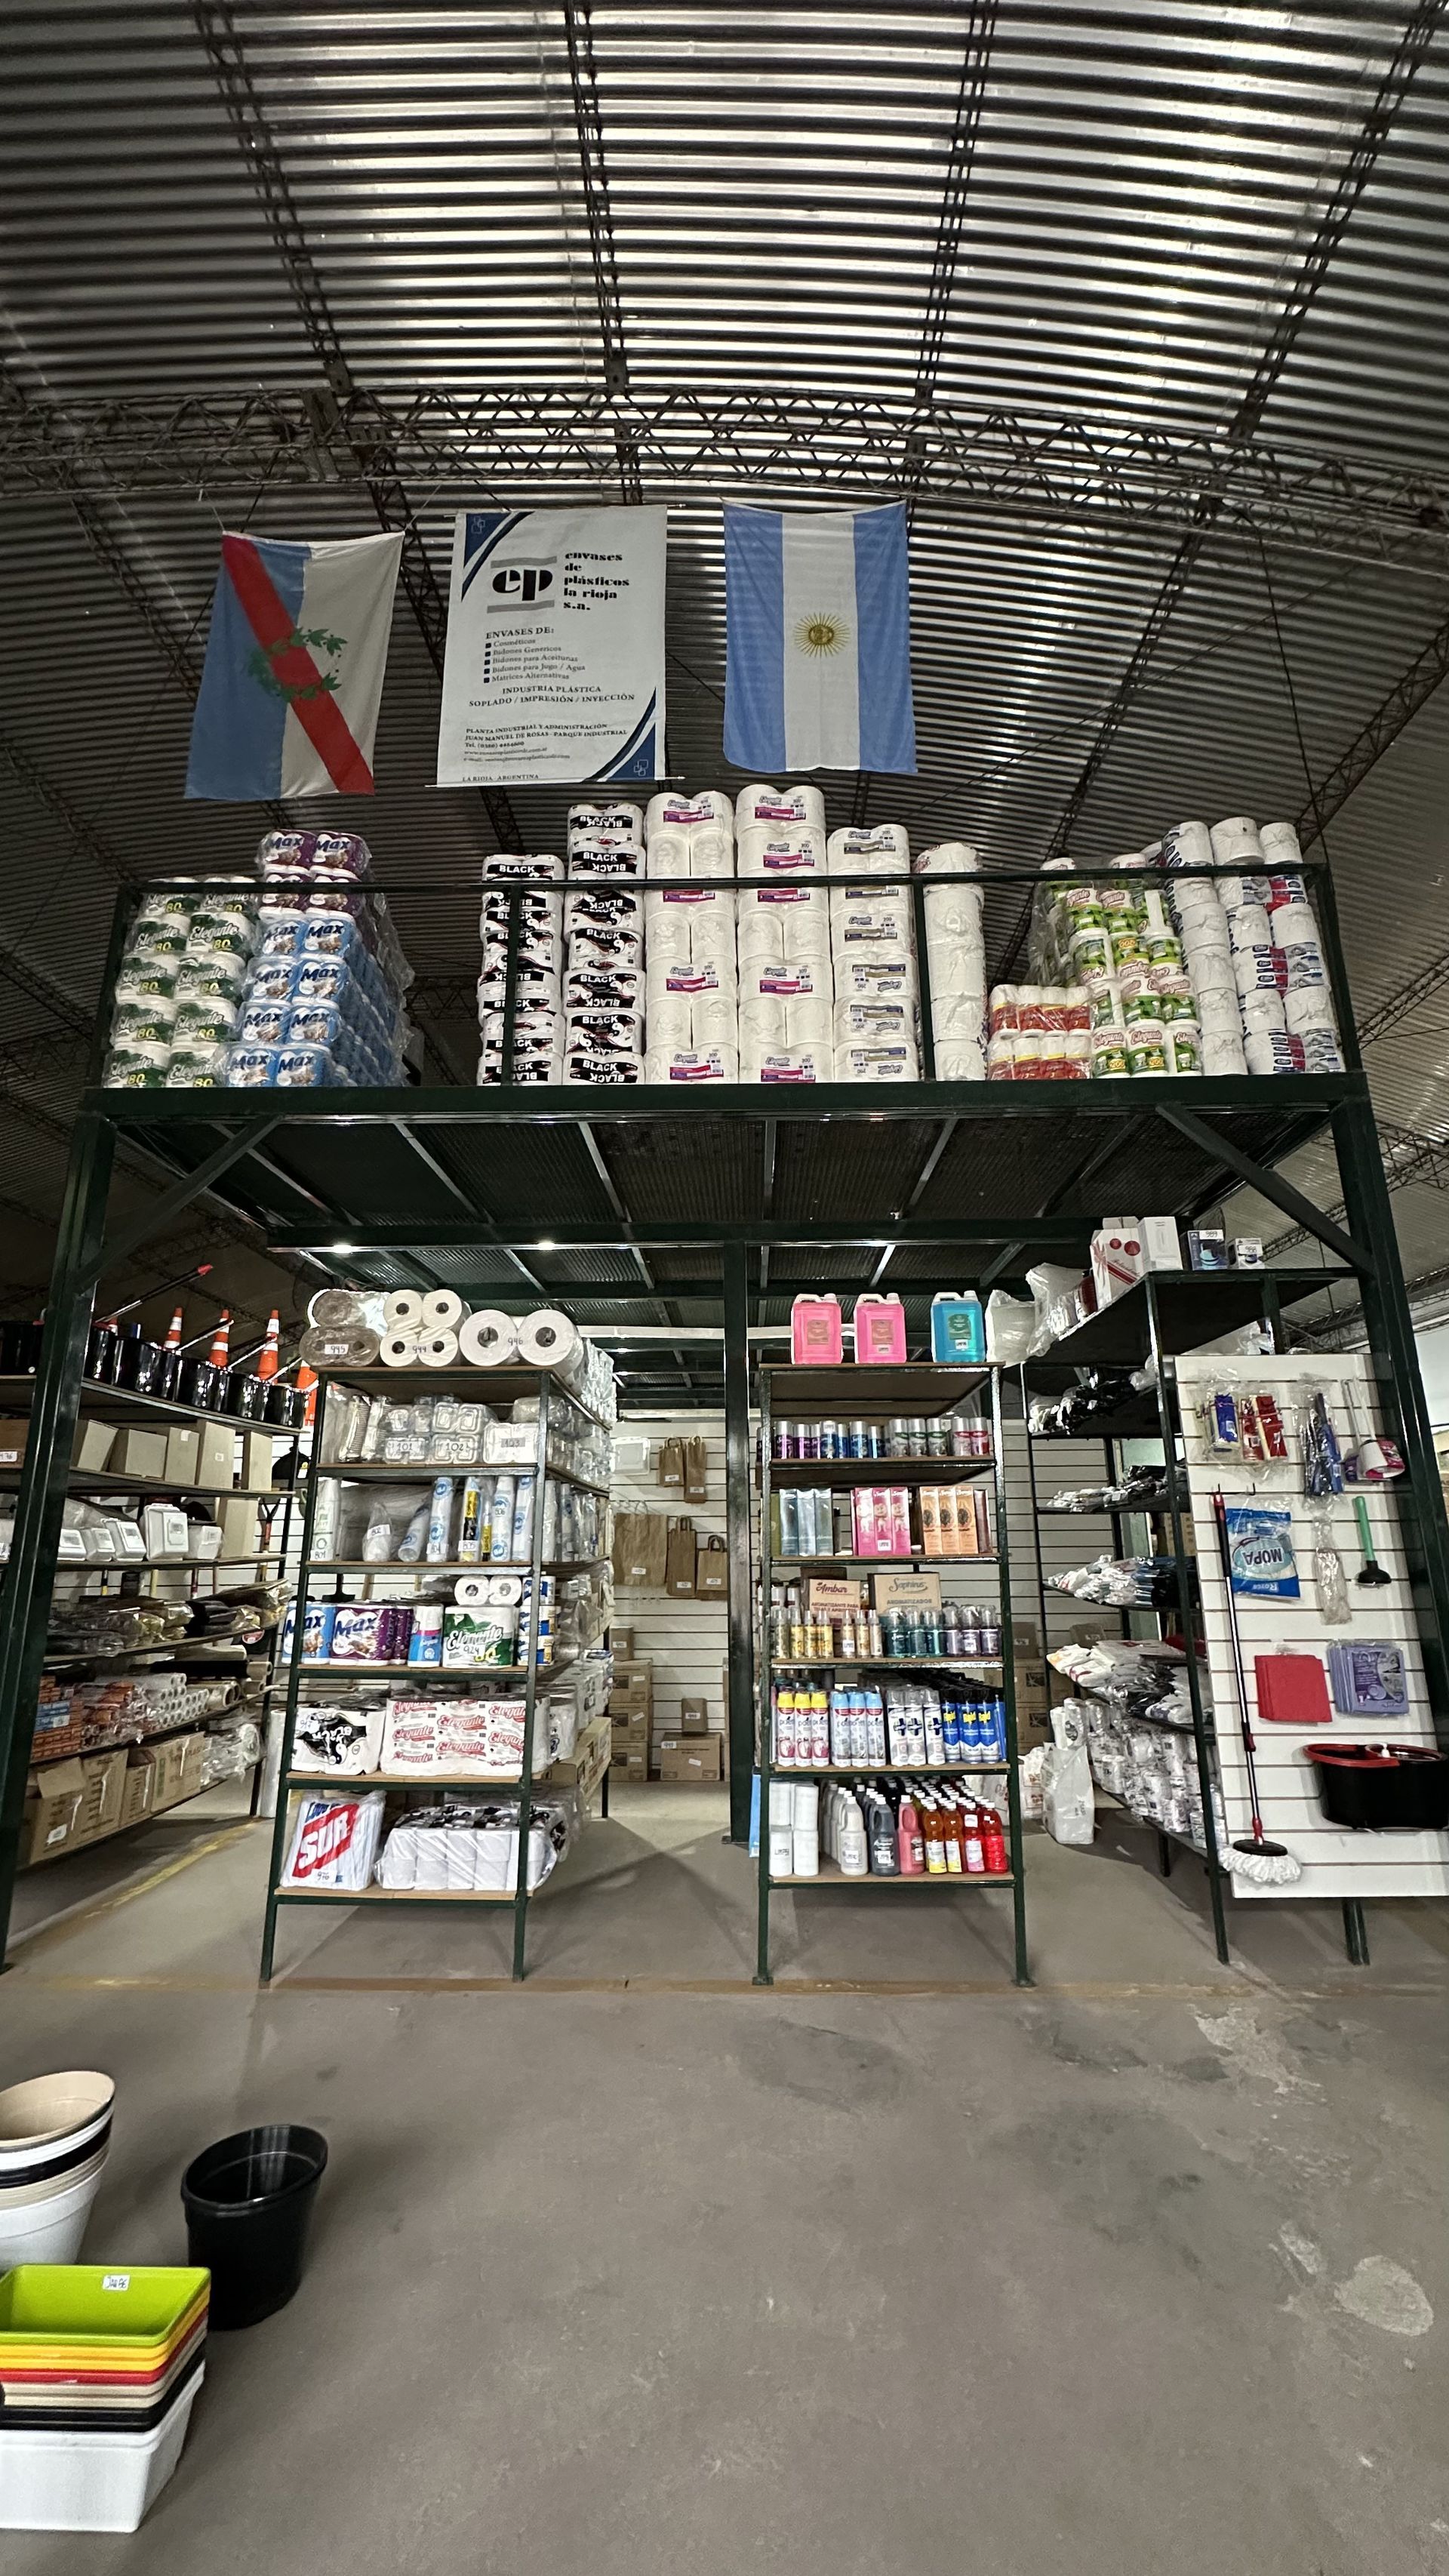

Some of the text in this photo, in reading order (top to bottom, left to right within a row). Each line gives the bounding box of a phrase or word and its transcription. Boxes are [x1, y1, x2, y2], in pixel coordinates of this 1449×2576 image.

[565, 552, 623, 561] envases
[565, 563, 583, 571] de
[492, 569, 553, 602] ep
[564, 575, 629, 586] plásticos
[564, 587, 617, 601] la rioja
[563, 602, 591, 611] s.a.
[486, 628, 533, 639] ENVASES
[493, 639, 536, 648] Cosméticos
[523, 656, 539, 664] para
[492, 664, 521, 673] Bidones
[491, 674, 524, 682] Matrices
[502, 685, 601, 694] INDUSTRIA PLÁSTICA
[469, 697, 512, 707] SOPLADO
[520, 694, 574, 703] IMPRESIÓN
[582, 694, 635, 703] INYECCIÓN
[316, 840, 350, 851] Max
[583, 852, 617, 862] BLACK
[499, 865, 535, 873] BLACK
[592, 863, 626, 872] BLACK
[589, 900, 623, 908] BLACK
[189, 923, 239, 942] Elegante
[308, 925, 344, 937] Max
[586, 928, 620, 940] BLACK
[213, 939, 231, 949] 80
[300, 968, 340, 981] Max
[495, 972, 531, 980] BLCK
[580, 974, 616, 983] BLACK
[494, 999, 530, 1008] BLCK
[586, 999, 620, 1007] BLACK
[582, 1015, 618, 1024] BLACK
[137, 1028, 155, 1039] 80
[278, 1055, 314, 1073] Max
[583, 1060, 617, 1071] BLACK
[168, 1058, 214, 1081] Elegant
[128, 1073, 146, 1084] 80
[590, 1073, 625, 1082] BLACK
[508, 1337, 524, 1346] 946
[331, 1346, 346, 1354] 945
[396, 1442, 413, 1451] 101
[445, 1442, 463, 1451] 102
[1242, 1548, 1283, 1565] MOPA
[816, 1582, 848, 1594] Ambar
[334, 1617, 377, 1638] Max
[463, 1646, 480, 1655] 924
[489, 1705, 526, 1718] Elegan
[438, 1715, 486, 1729] Elegante
[393, 1726, 434, 1740] Elegante
[489, 1731, 525, 1747] Elegan
[437, 1741, 485, 1754] Elegante
[298, 1811, 349, 1870] SUR
